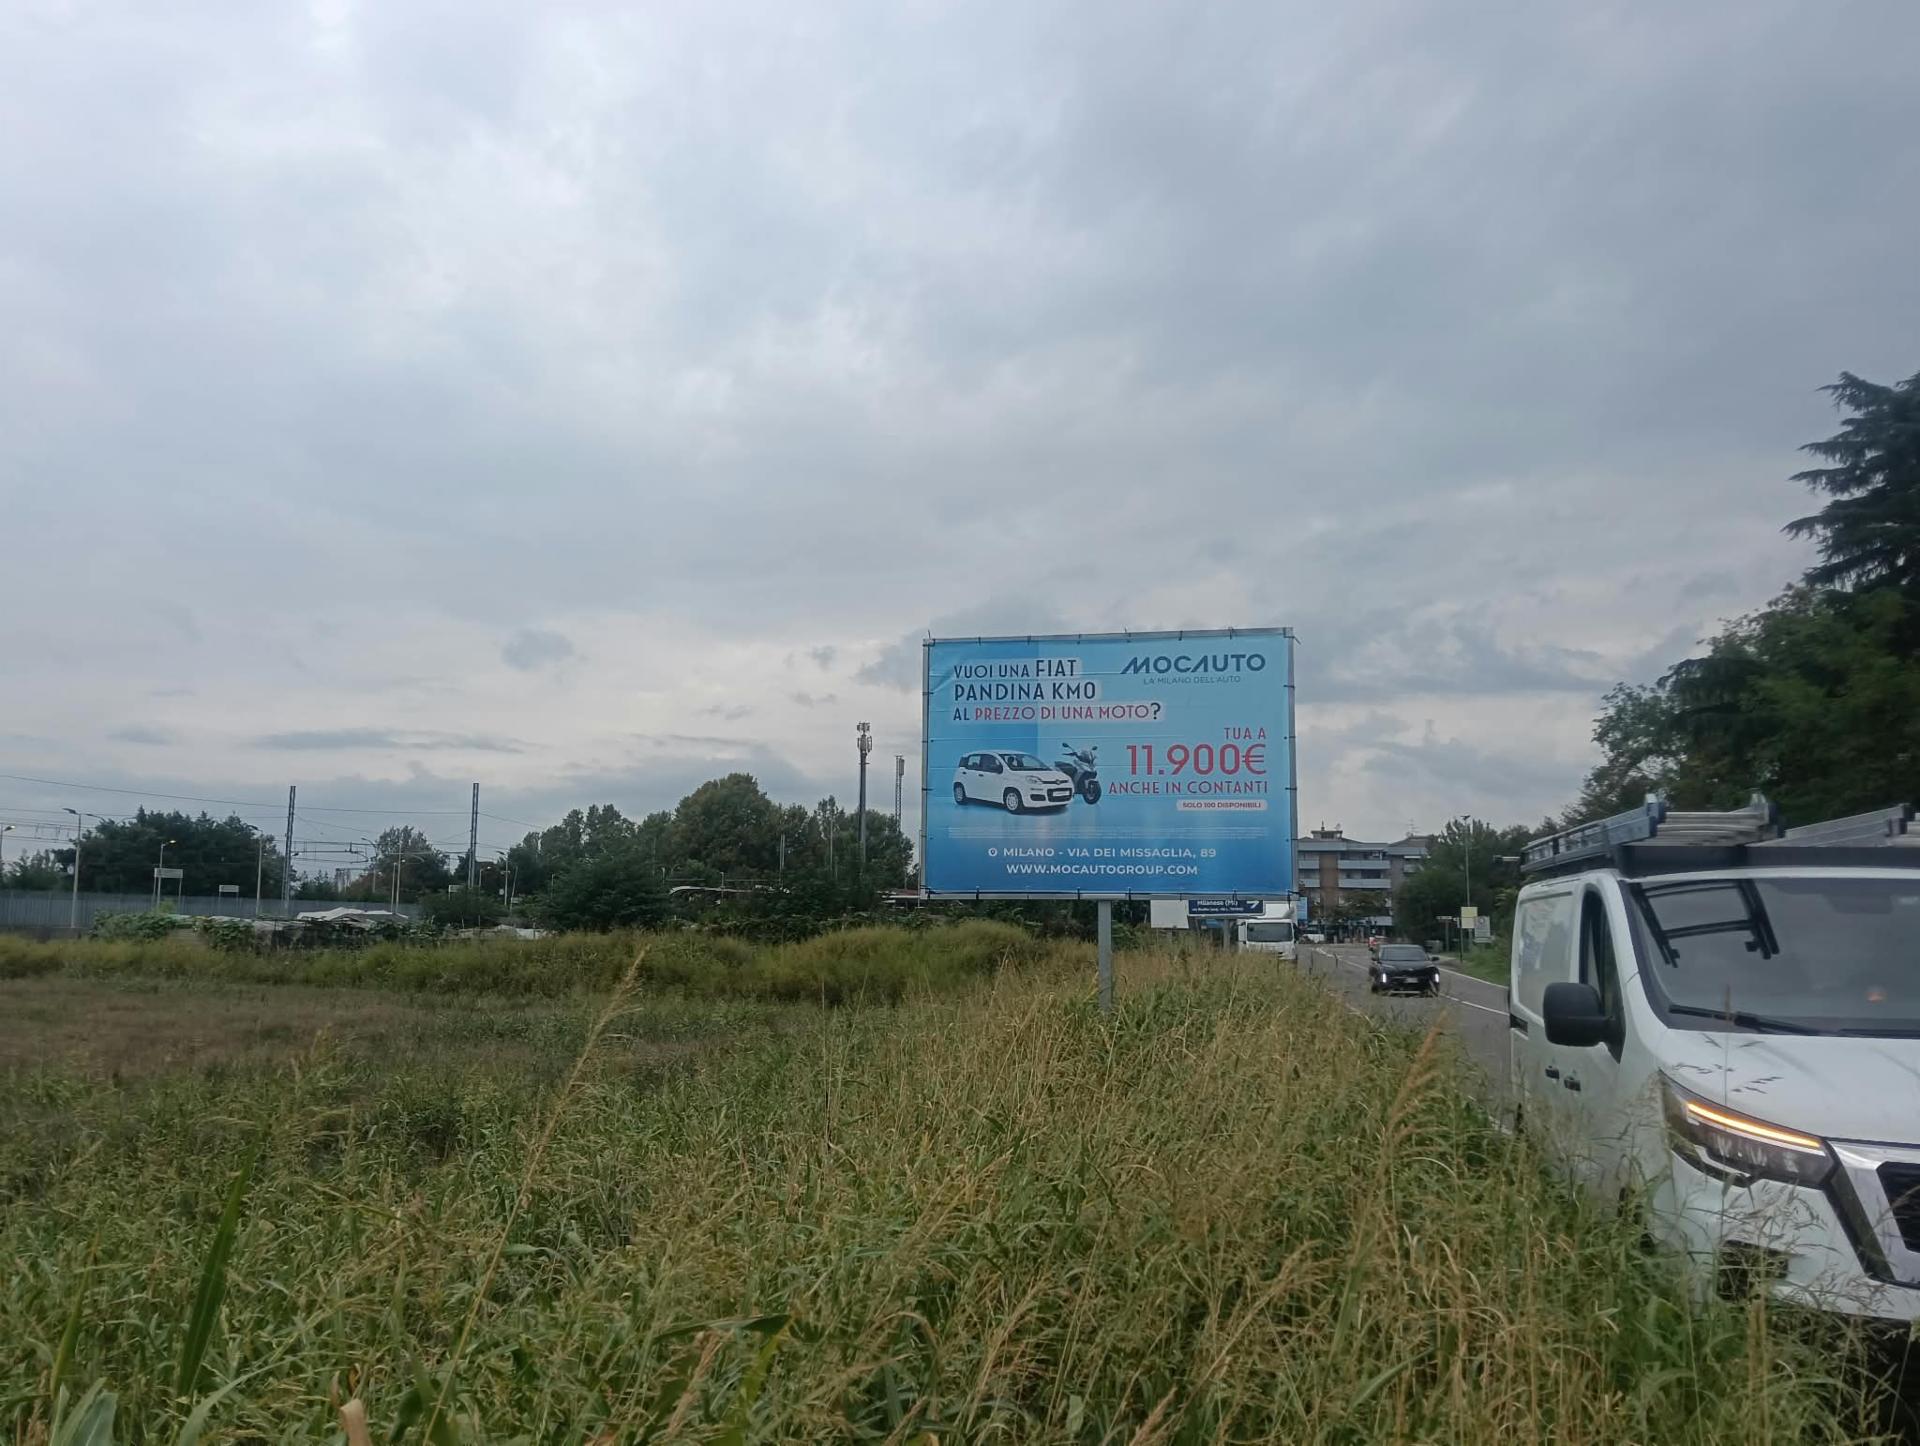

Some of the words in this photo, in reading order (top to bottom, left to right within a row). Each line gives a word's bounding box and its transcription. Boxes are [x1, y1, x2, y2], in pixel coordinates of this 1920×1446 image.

[954, 664, 993, 678] VUOI
[999, 663, 1030, 678] UNA
[1036, 659, 1077, 677] FIAT
[1120, 653, 1266, 675] MOCAUTO
[1157, 676, 1192, 684] MILANO
[954, 682, 1045, 701] PANDINA
[953, 707, 970, 721] AL
[975, 706, 1036, 721] PREZZO
[1041, 706, 1056, 720] DI
[1062, 705, 1094, 720] UNA
[1099, 702, 1161, 720] MOTO?
[1224, 727, 1252, 740] TUA
[1258, 727, 1267, 740] A
[1126, 743, 1267, 776] 11.900€
[1108, 781, 1160, 794] ANCHE
[1165, 781, 1181, 794] IN
[1187, 780, 1268, 794] CONTANTI
[1182, 801, 1203, 809] SOLO
[1217, 801, 1261, 809] DISPONIBILI
[1003, 847, 1055, 857] MILANO
[1067, 848, 1089, 857] VIA
[1093, 848, 1116, 857] DEI
[1119, 848, 1197, 859] MISSAGLIA,
[1200, 848, 1217, 858] 89
[1006, 864, 1198, 875] WWW.MOCAUTOGROUP.COM
